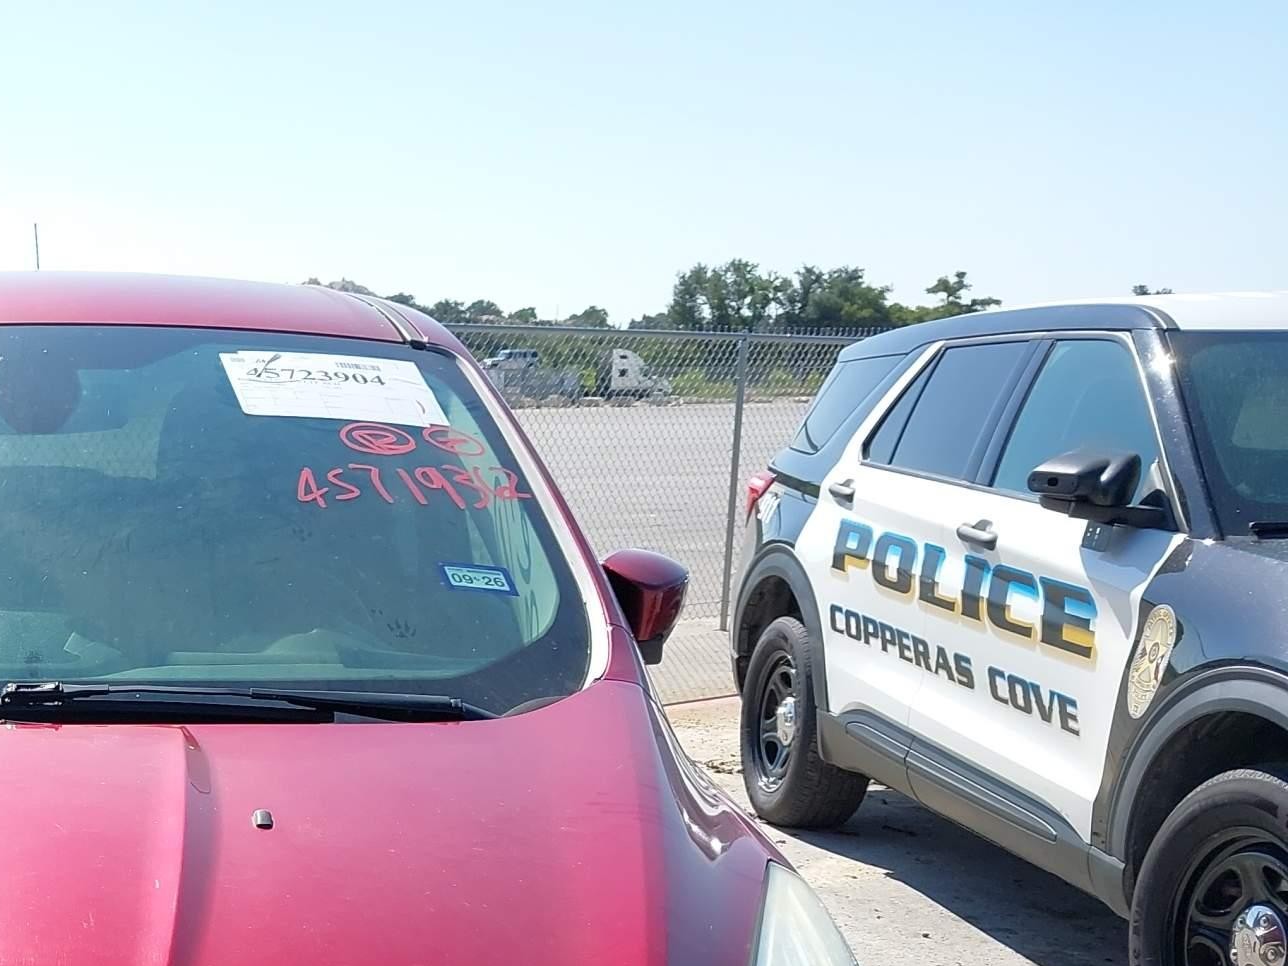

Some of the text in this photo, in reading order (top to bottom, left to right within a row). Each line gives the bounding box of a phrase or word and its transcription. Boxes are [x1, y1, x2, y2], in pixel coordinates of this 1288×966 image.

[831, 518, 1099, 660] POLICE
[829, 604, 975, 690] COPPERAS
[987, 666, 1081, 737] COVE
